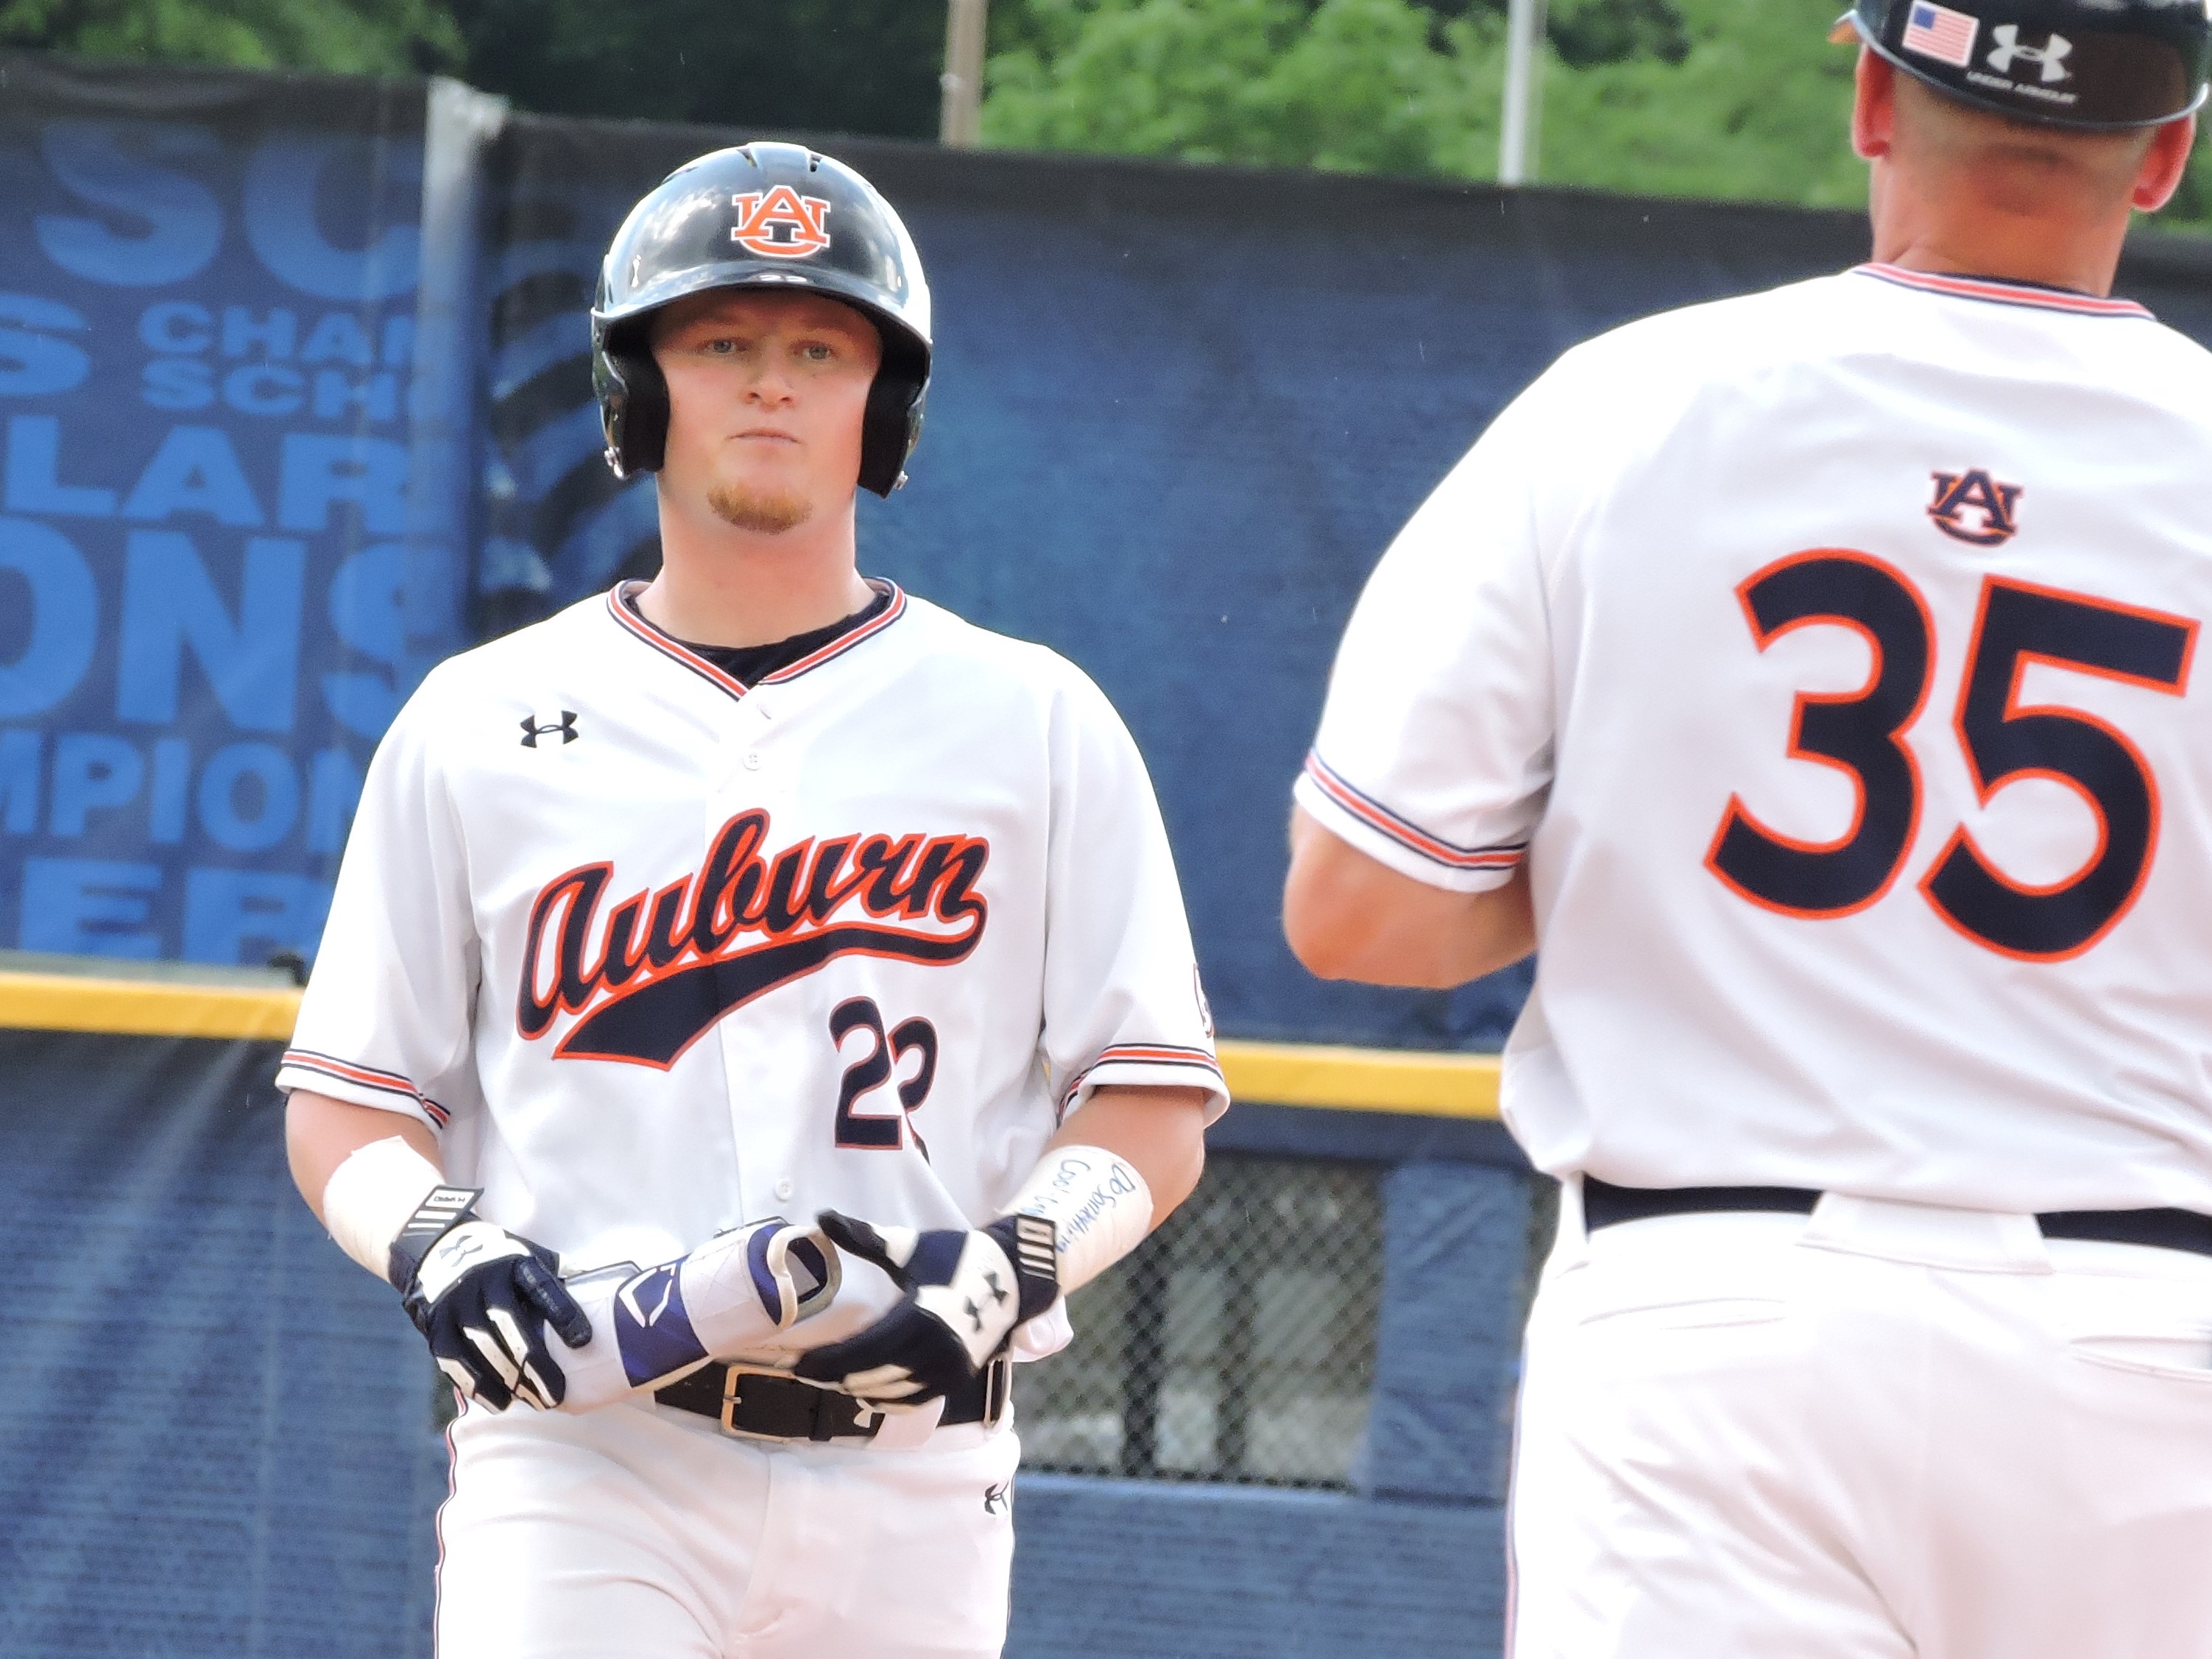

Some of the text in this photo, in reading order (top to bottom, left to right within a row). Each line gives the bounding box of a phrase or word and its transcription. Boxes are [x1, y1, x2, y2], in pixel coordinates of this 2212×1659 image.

[141, 359, 416, 422] SCH
[1703, 546, 2201, 963] 35
[515, 807, 989, 1053] Auburn
